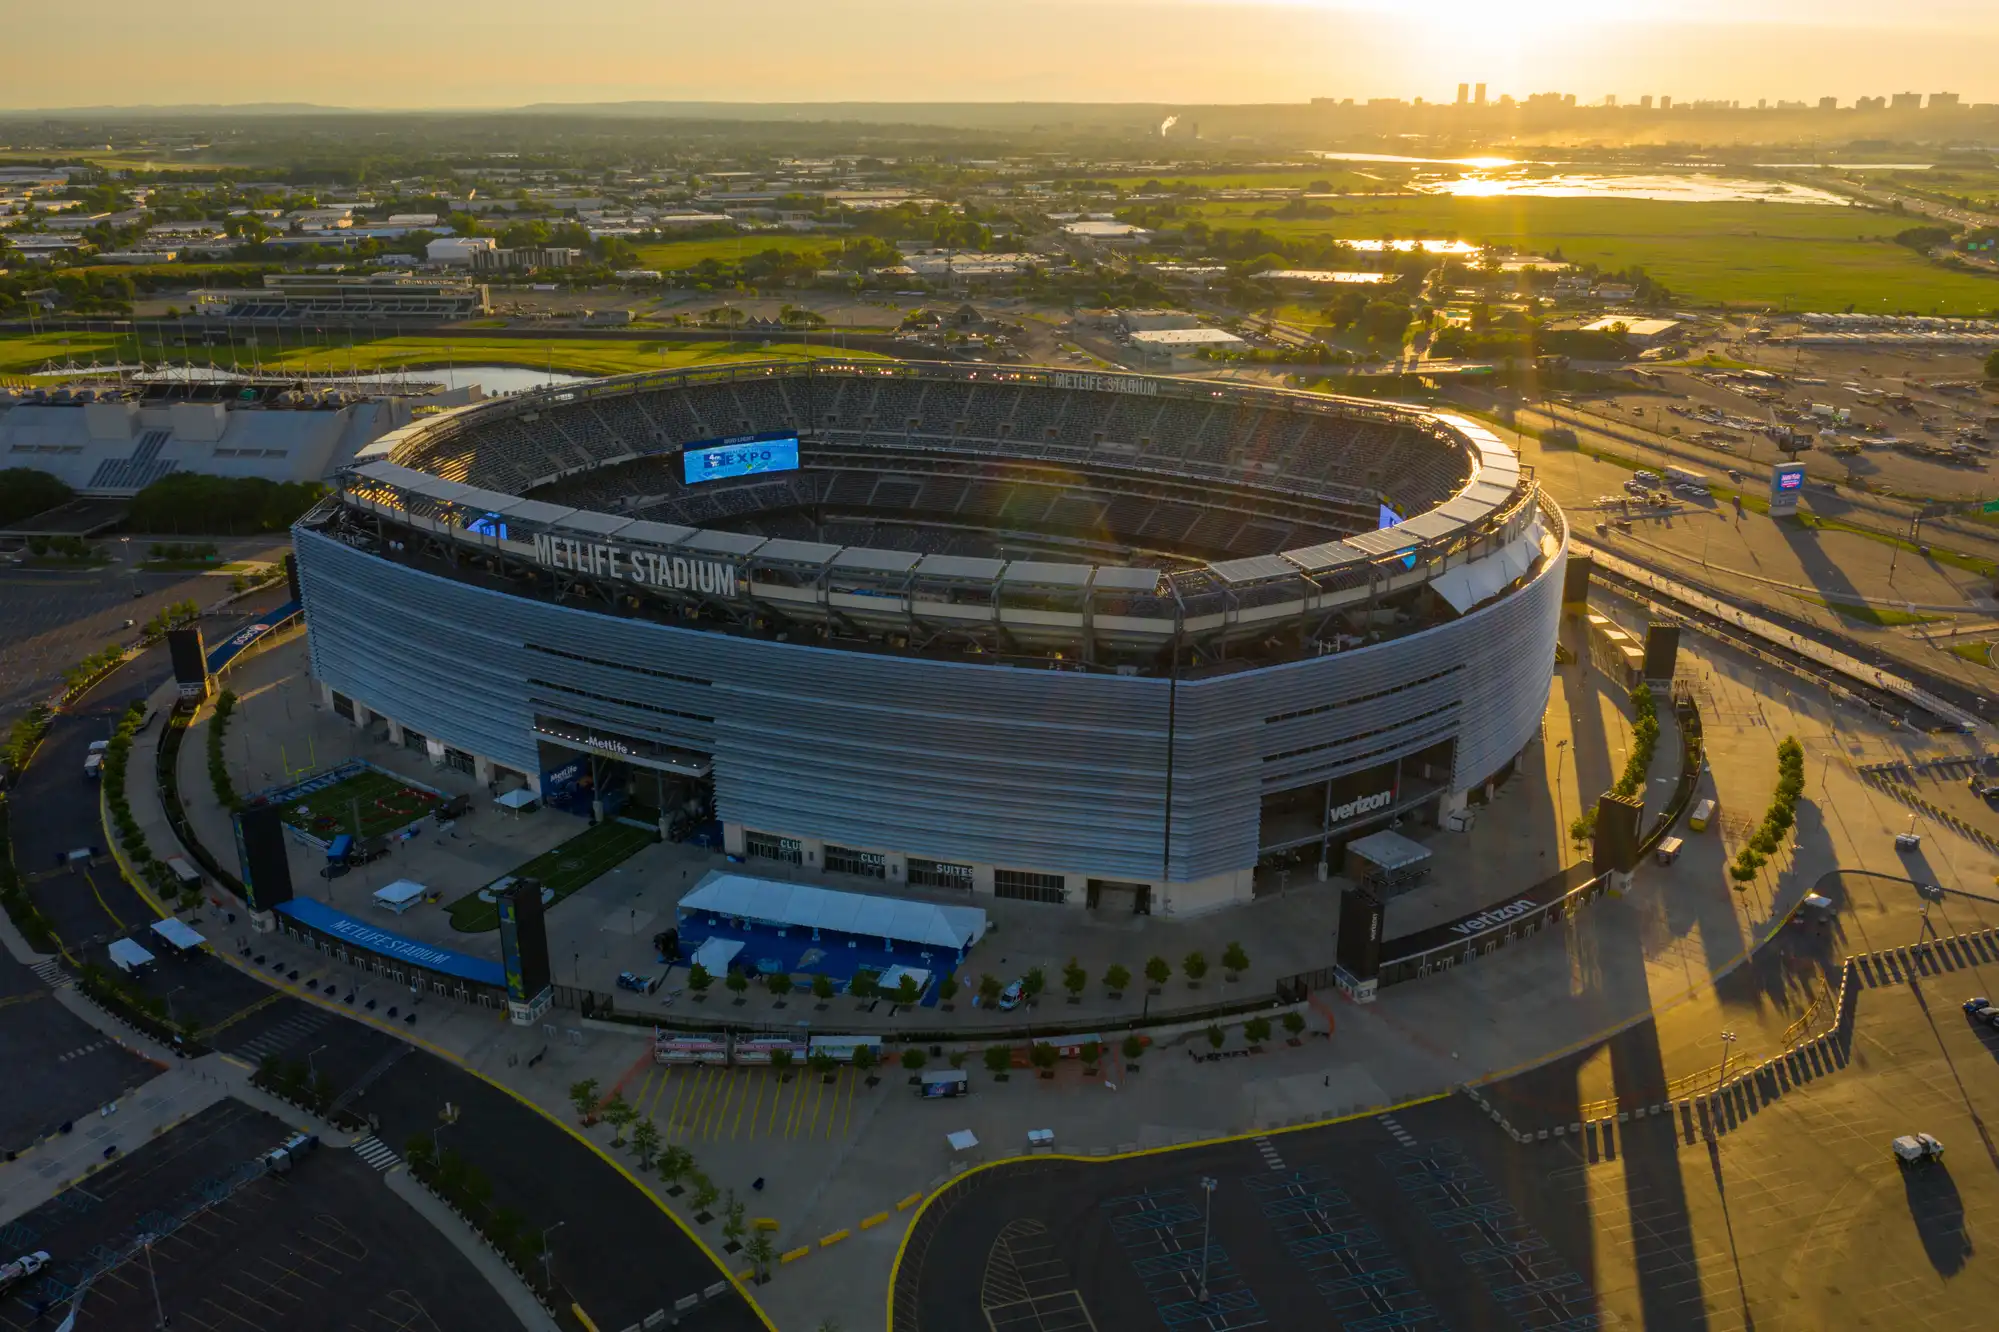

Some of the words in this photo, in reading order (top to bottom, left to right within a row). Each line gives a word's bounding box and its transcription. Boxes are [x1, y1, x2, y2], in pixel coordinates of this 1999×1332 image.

[1055, 372, 1103, 392] METLIFE
[1107, 379, 1157, 397] STADIUM
[727, 450, 771, 465] EXPO
[533, 533, 623, 579] METLIFE
[630, 550, 735, 597] STADIUM
[588, 736, 628, 754] MetLife
[550, 765, 578, 782] MetLife
[1330, 790, 1391, 822] verizon
[937, 864, 973, 877] SUITES
[1450, 899, 1537, 935] verizon
[330, 920, 393, 946] METLIFE
[386, 940, 451, 965] STADIUM
